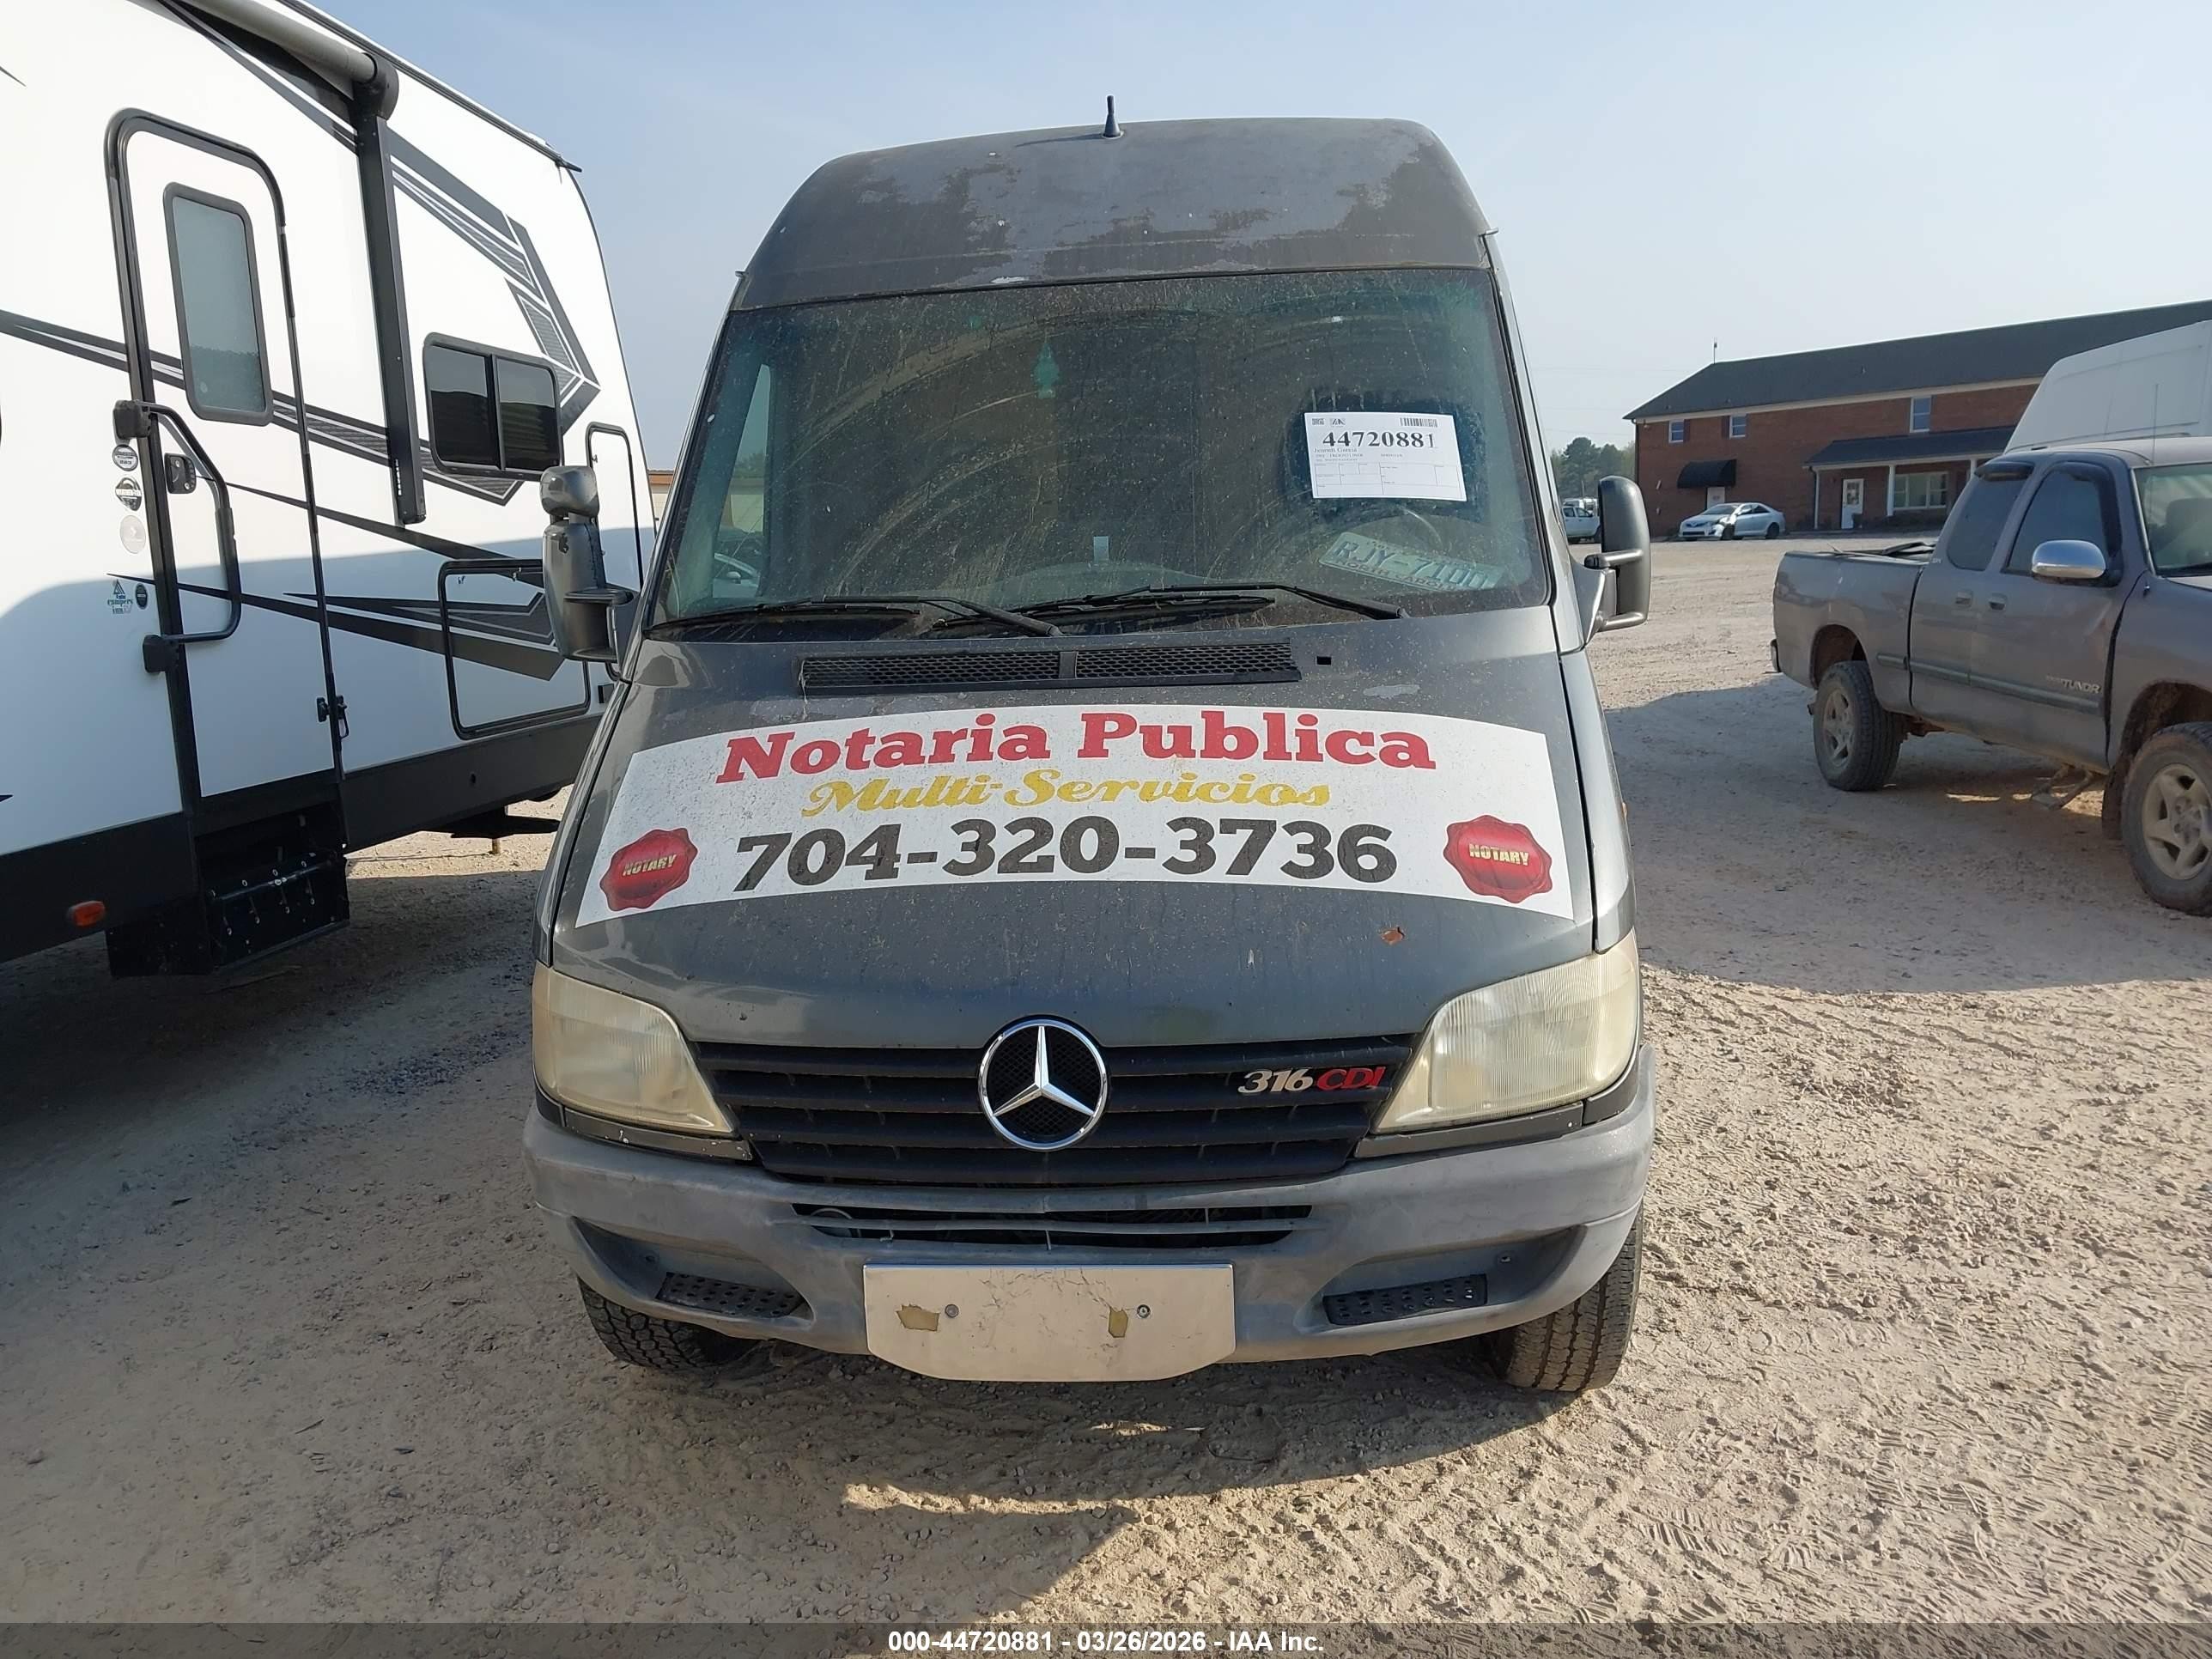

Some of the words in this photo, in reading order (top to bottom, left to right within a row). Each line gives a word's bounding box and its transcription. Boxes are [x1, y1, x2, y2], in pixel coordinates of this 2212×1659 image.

[1322, 431, 1435, 448] 44720881
[2061, 678, 2102, 694] TUNDR
[717, 714, 1051, 783] Notaria
[1077, 710, 1436, 769] Publica
[800, 769, 1330, 817] Multi-Servicios
[623, 854, 677, 877] NOTARY
[733, 815, 1397, 893] 704-320-3736
[1468, 843, 1529, 866] NOTARY
[1238, 1068, 1314, 1093] 316
[1316, 1066, 1386, 1091] CDI
